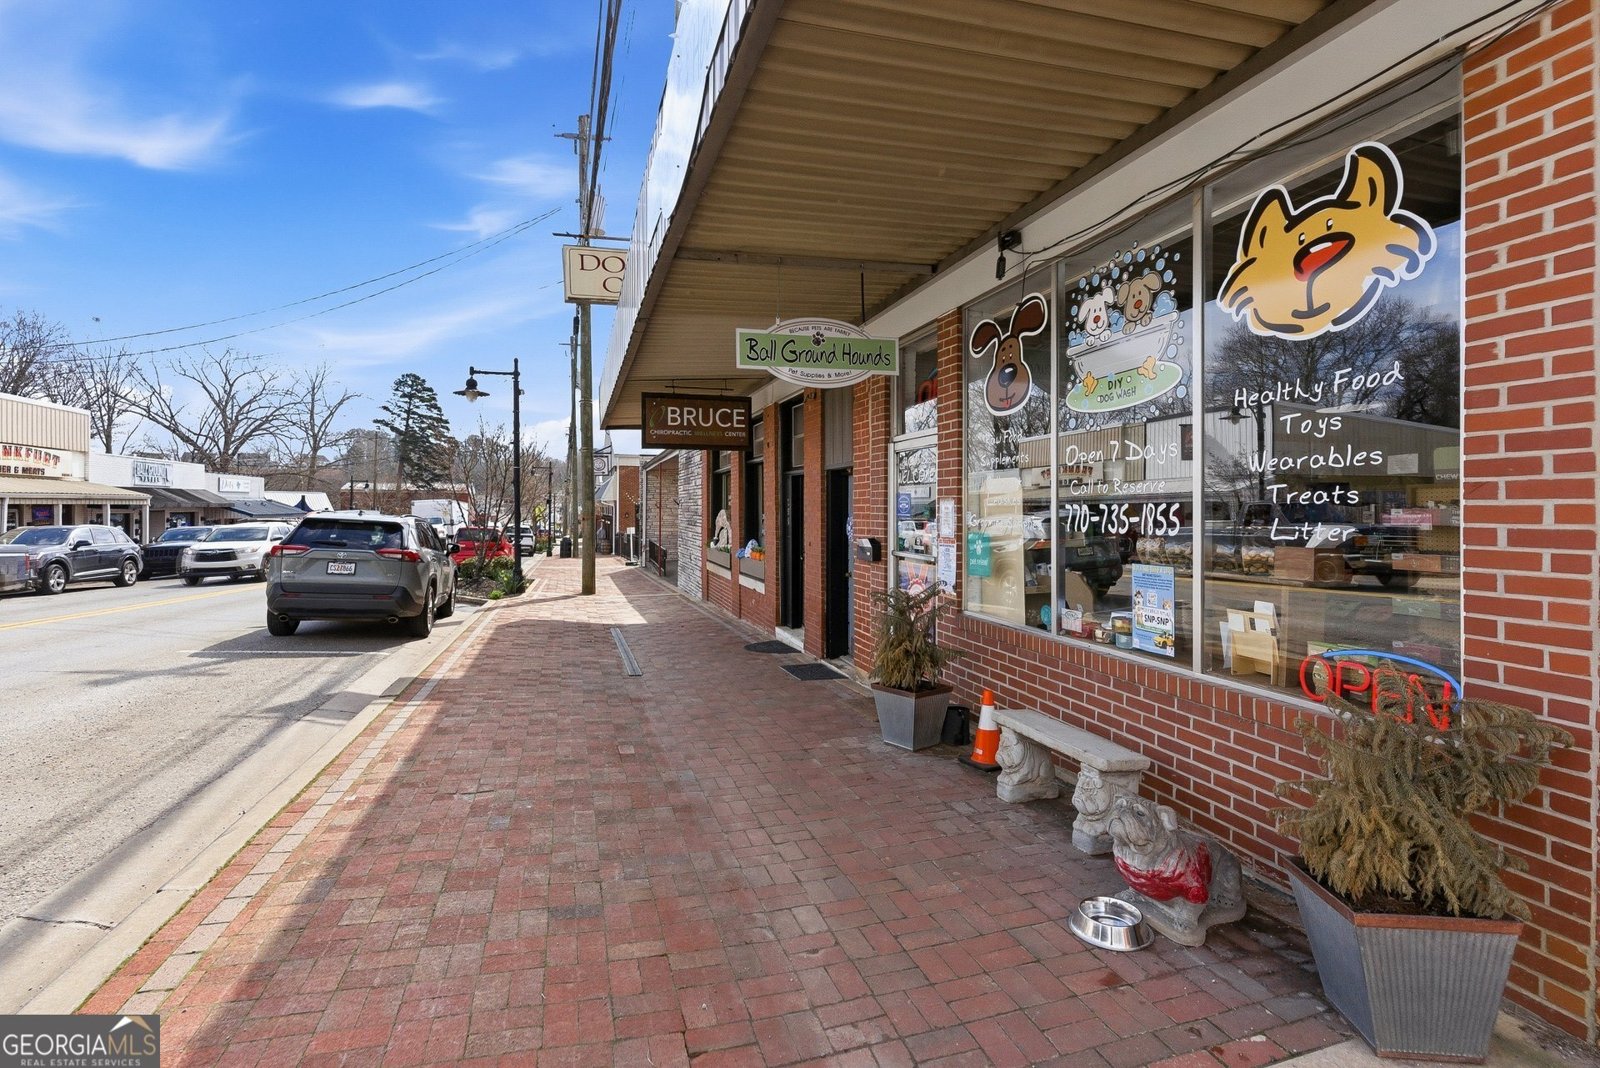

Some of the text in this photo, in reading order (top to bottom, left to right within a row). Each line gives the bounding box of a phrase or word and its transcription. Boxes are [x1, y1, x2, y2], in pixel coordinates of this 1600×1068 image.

[788, 325, 810, 334] BECAUSE
[834, 328, 851, 337] FAMILY
[745, 337, 891, 366] Ball Ground Hounds
[788, 367, 798, 375] Pet
[800, 370, 825, 378] Supplies
[834, 370, 852, 378] More!
[1107, 376, 1124, 391] DIY
[1099, 386, 1137, 403] DOG WASH
[1234, 360, 1405, 409] Healthy Food
[667, 406, 746, 428] BRUCE
[1280, 412, 1343, 438] Toys
[650, 429, 692, 437] CHIROPRACTIC
[1065, 444, 1105, 470] Open
[1109, 440, 1120, 463] 7
[1124, 439, 1179, 465] Days
[1249, 443, 1384, 474] Wearables
[21, 466, 46, 476] MEATS
[1070, 479, 1094, 496] Call
[1096, 478, 1109, 496] to
[1112, 477, 1166, 495] Reserve
[1266, 484, 1360, 505] Treats
[1065, 502, 1181, 537] 770-735-1855
[1270, 517, 1356, 542] Litter
[1299, 654, 1451, 732] OPEN
